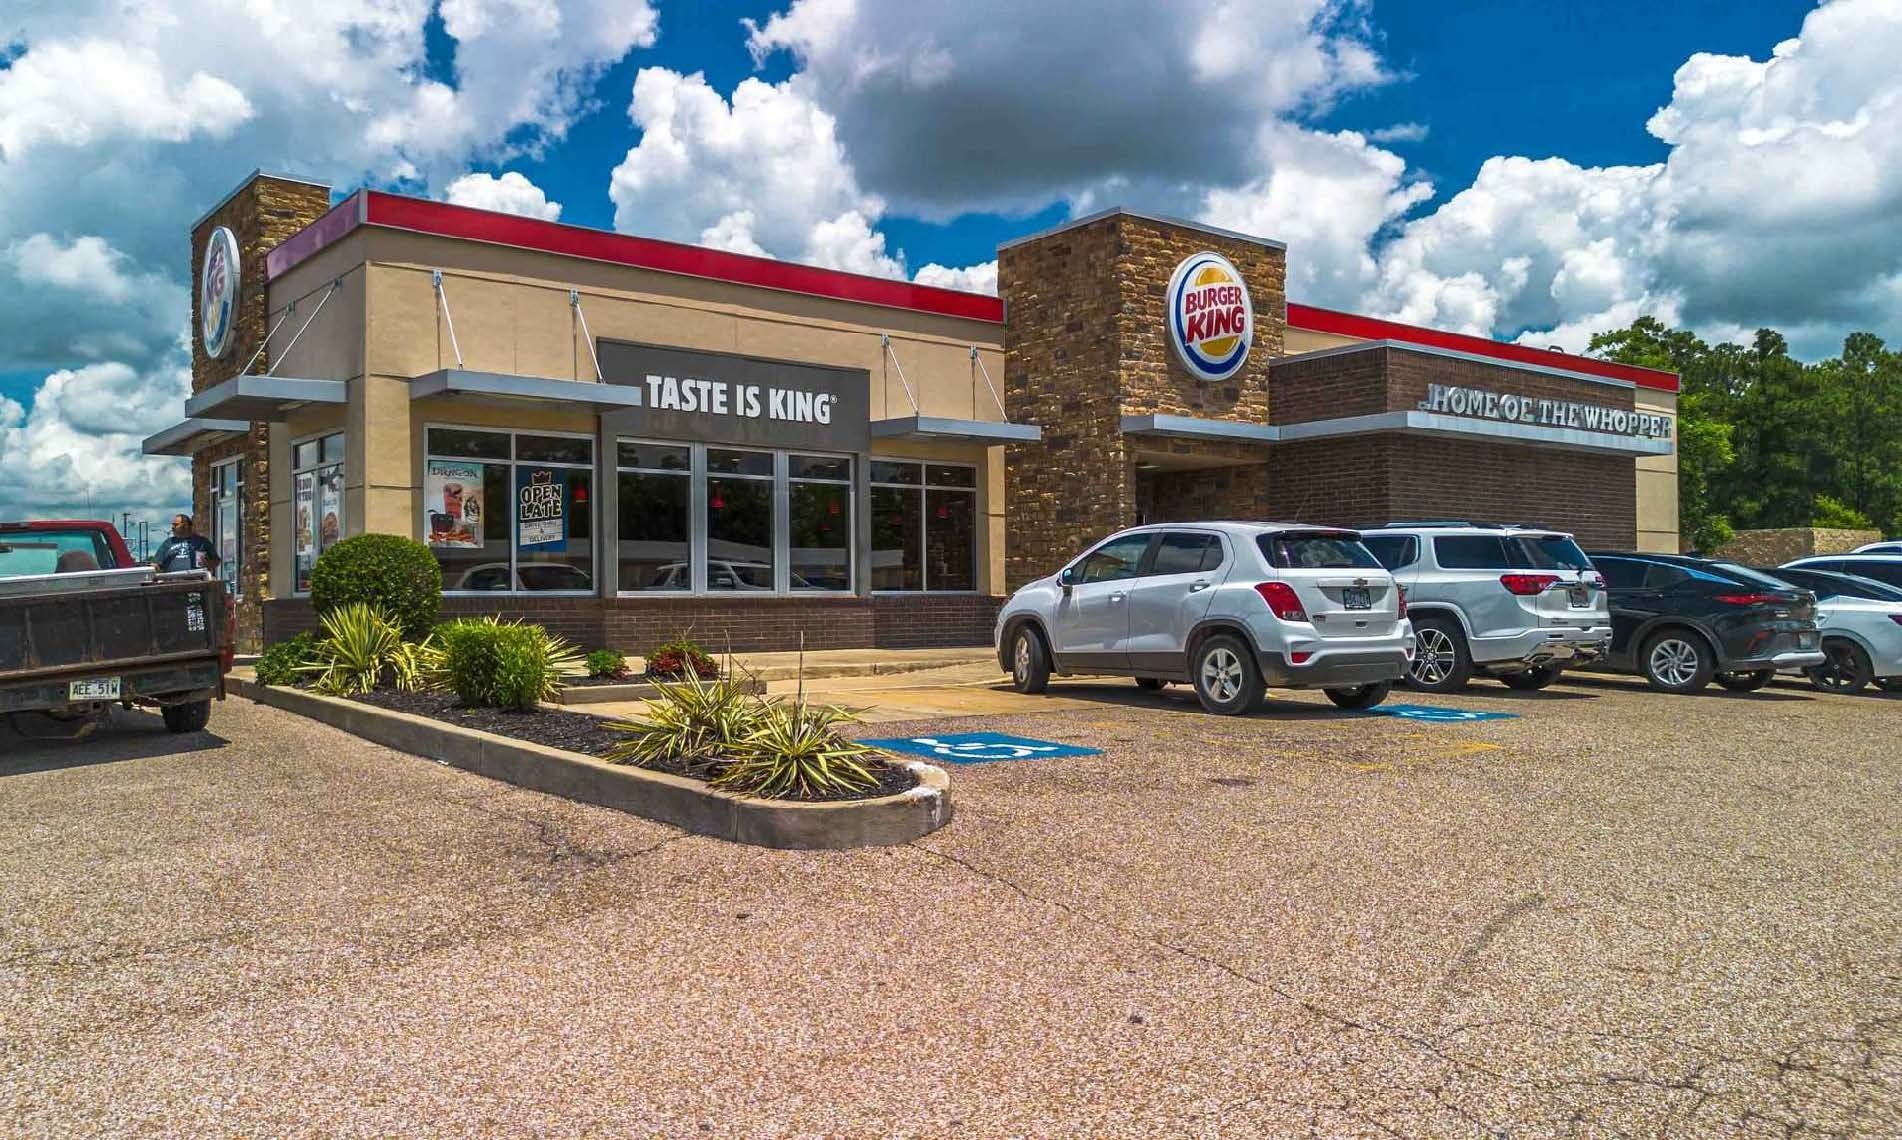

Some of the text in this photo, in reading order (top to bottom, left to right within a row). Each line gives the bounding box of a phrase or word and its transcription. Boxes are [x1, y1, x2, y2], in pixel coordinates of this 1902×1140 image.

[1185, 286, 1242, 315] BURGER
[1187, 306, 1245, 343] KING
[646, 375, 728, 415] TASTE
[736, 384, 760, 418] IS
[1429, 384, 1499, 419] HOME
[1538, 399, 1581, 430] THE
[521, 484, 562, 505] OPEN
[521, 500, 562, 520] LATE
